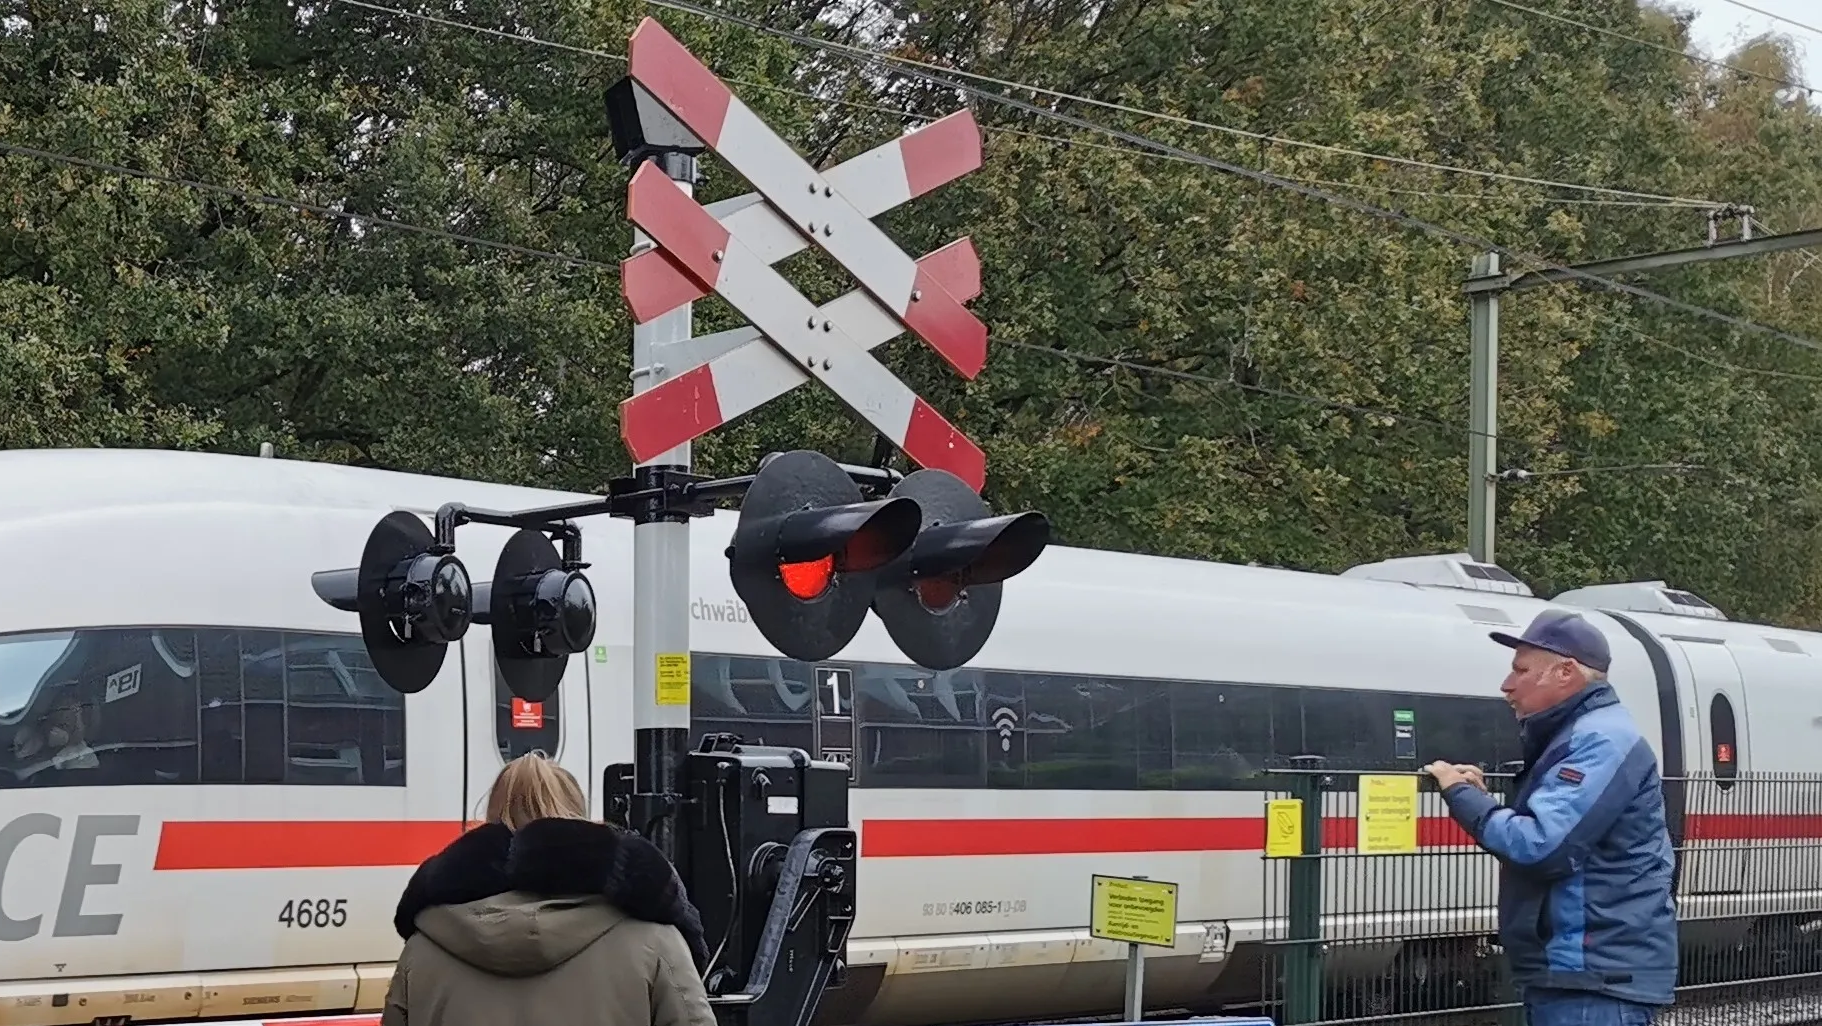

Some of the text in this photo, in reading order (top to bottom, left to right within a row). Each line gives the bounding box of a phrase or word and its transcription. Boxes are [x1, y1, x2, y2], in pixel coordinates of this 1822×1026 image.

[690, 597, 749, 623] chwäb
[826, 671, 841, 715] 1
[277, 898, 348, 928] 4685
